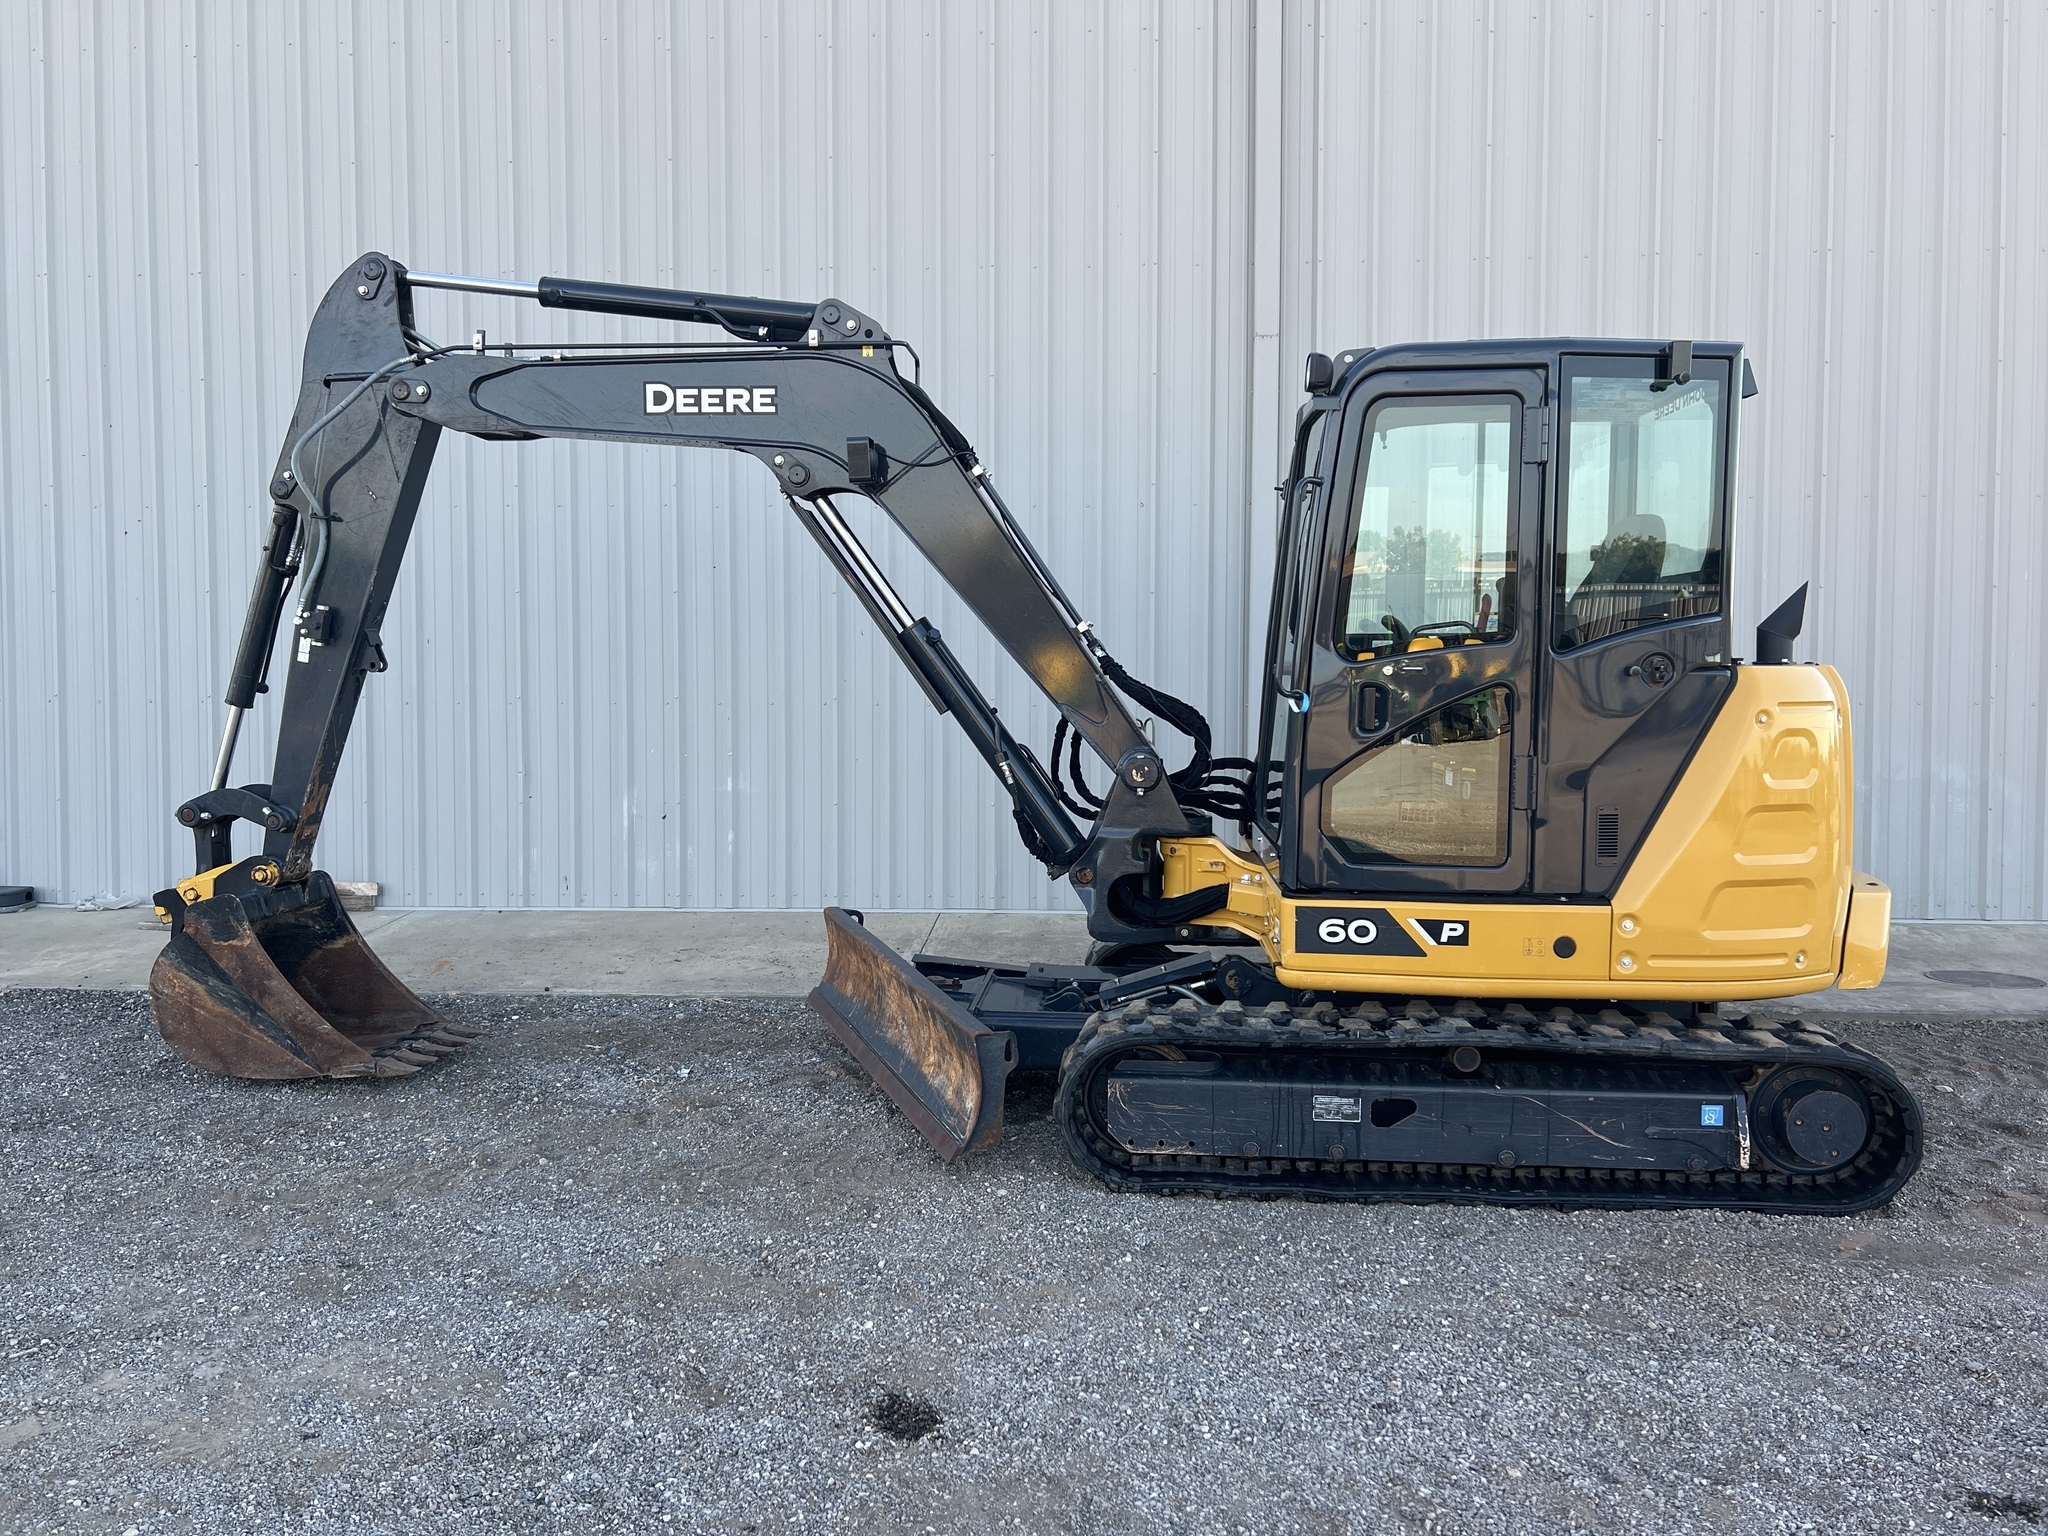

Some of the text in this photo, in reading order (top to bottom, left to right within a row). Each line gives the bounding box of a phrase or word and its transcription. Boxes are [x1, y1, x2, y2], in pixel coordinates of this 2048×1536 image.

[645, 383, 776, 413] DEERE
[1318, 918, 1464, 944] 60 P
